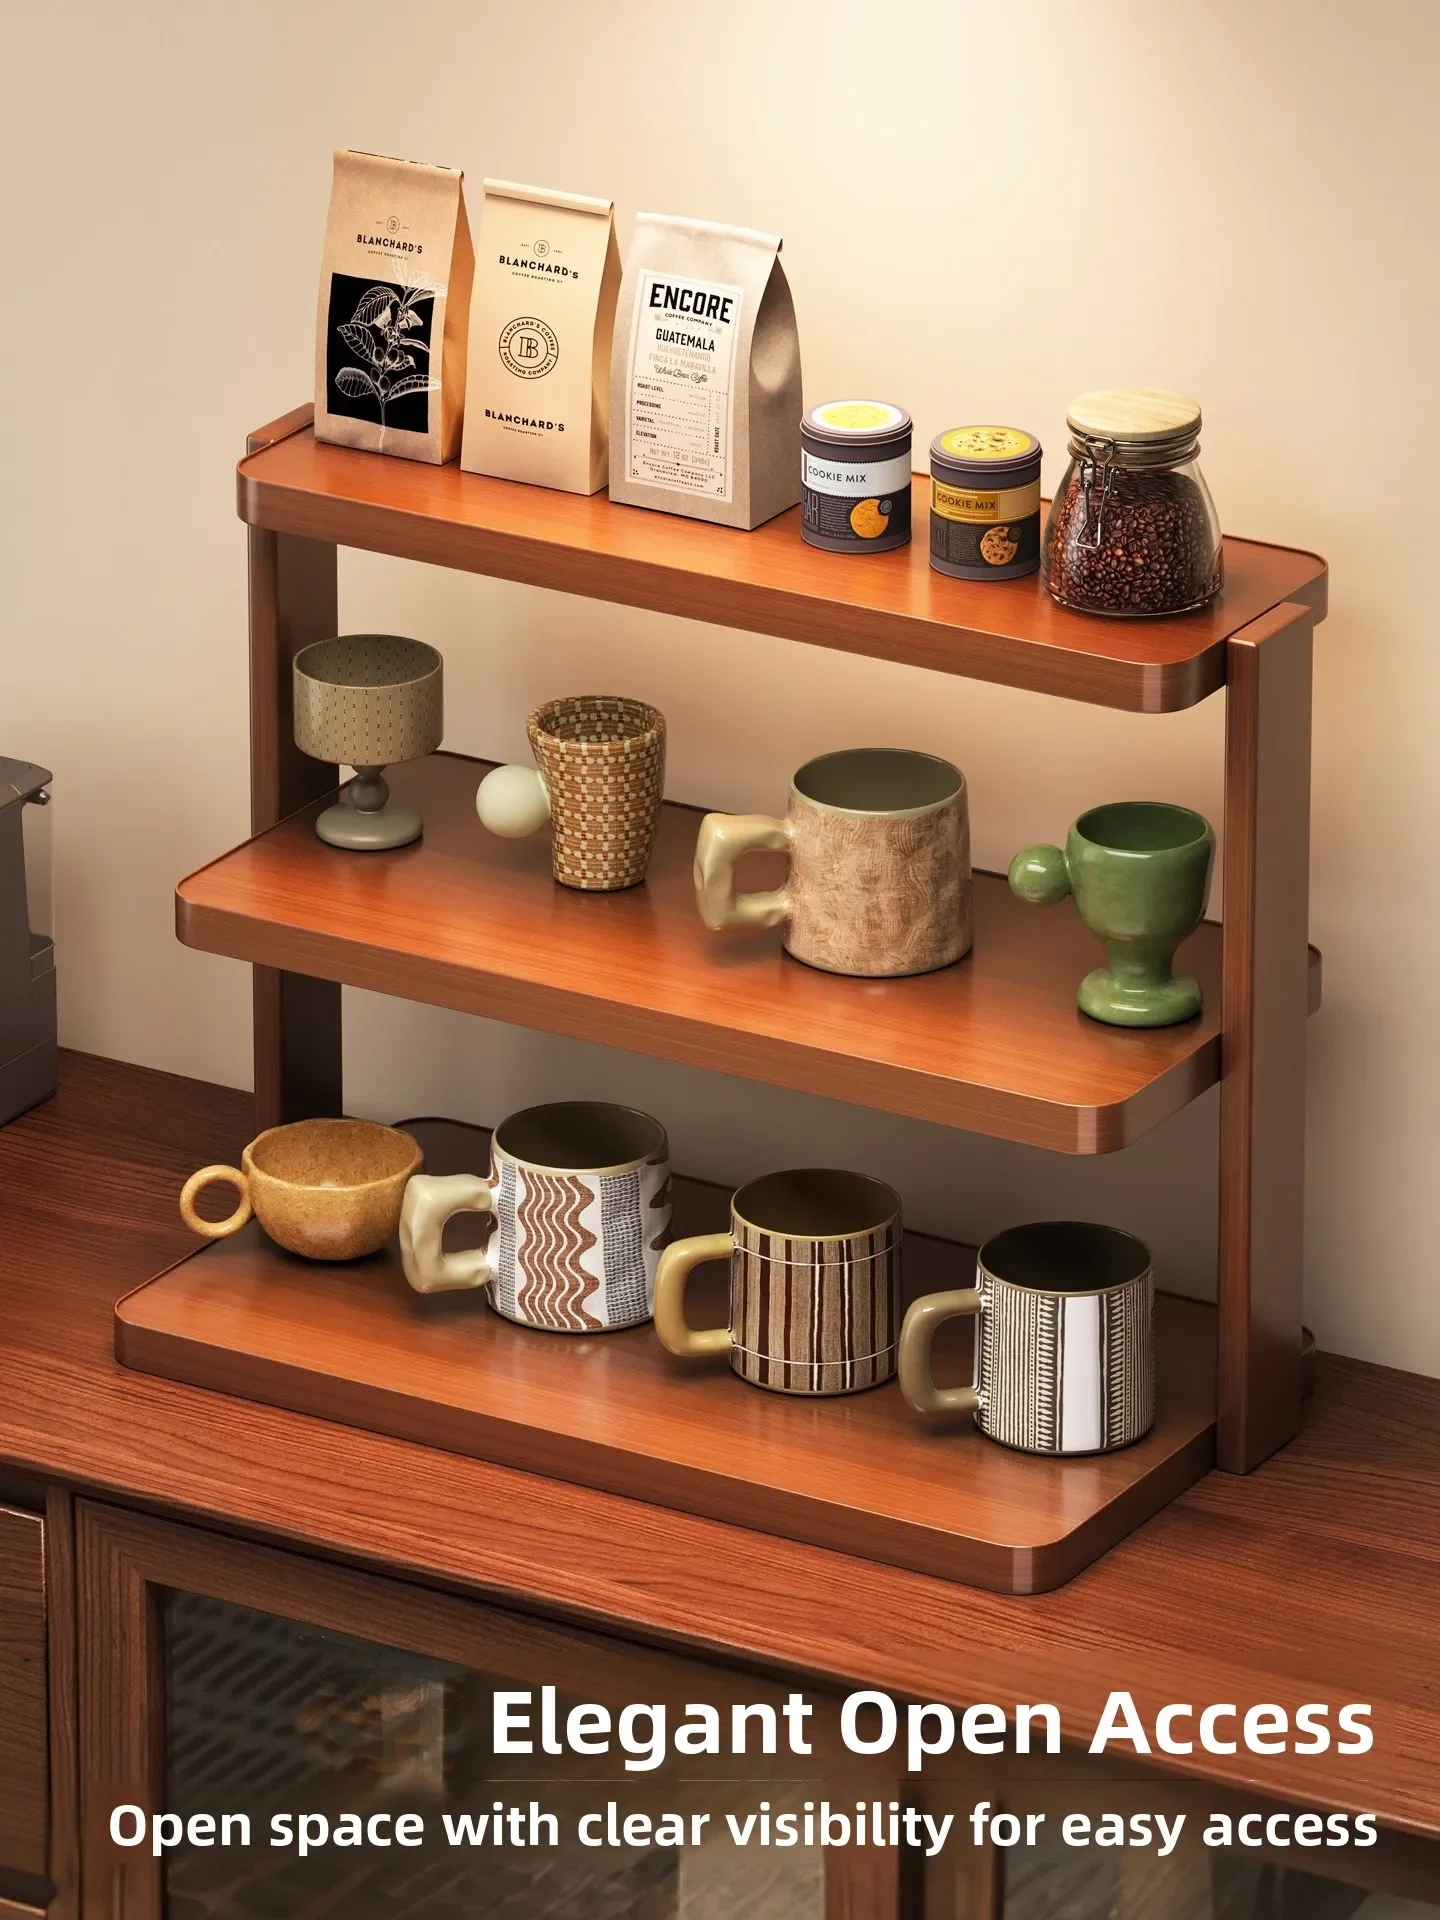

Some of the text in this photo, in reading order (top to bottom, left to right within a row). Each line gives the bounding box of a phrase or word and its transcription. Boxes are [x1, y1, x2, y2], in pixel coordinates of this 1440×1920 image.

[356, 233, 423, 254] BLANCHARD'S
[498, 255, 579, 279] BLANCHARD'S
[649, 283, 734, 324] ENCORE
[664, 312, 713, 327] COFFEE COMPANY
[502, 320, 541, 344] BLANCHARD'S
[655, 328, 715, 352] GUATEMALA
[503, 352, 553, 375] ROASTING COMPANY
[485, 408, 565, 432] BLANCHARD'S
[808, 465, 867, 483] COOKIE MIX
[936, 492, 972, 509] COOKIE
[975, 501, 996, 510] MIX
